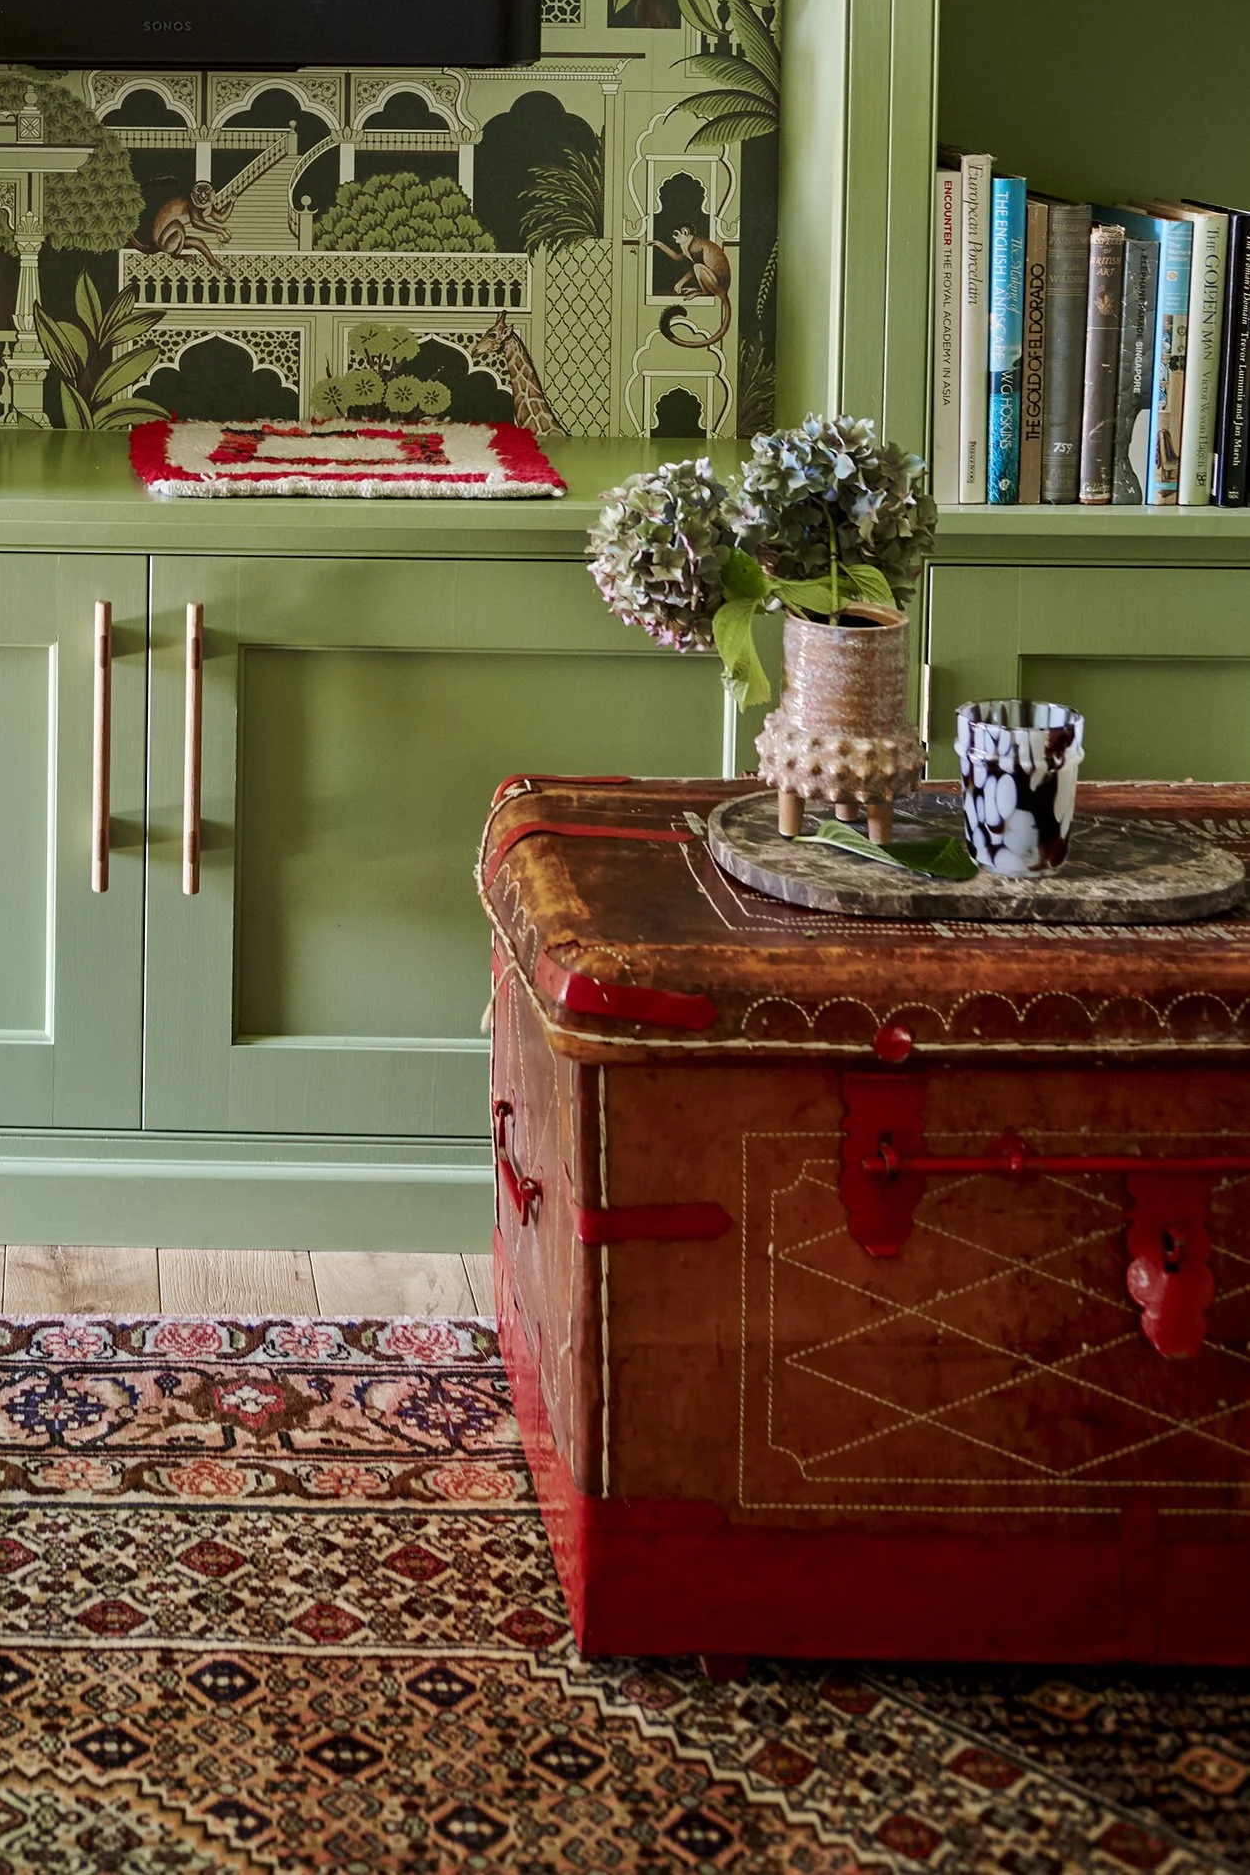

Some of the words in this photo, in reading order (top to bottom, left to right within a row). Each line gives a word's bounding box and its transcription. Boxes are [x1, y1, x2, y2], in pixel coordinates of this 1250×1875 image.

[143, 20, 192, 32] SONOS
[943, 180, 952, 246] ENCOUNTER
[962, 165, 983, 235] European
[996, 191, 1009, 219] THE
[943, 249, 952, 268] THE
[967, 240, 982, 305] Porcelain
[994, 220, 1008, 275] ENGLISH
[943, 272, 951, 307] ROYAL
[943, 310, 951, 364] ACADEMY
[992, 278, 1007, 359] LANDSCAPE
[942, 381, 951, 406] ASIA
[943, 367, 951, 378] IN
[1000, 398, 1013, 449] HOSKINS
